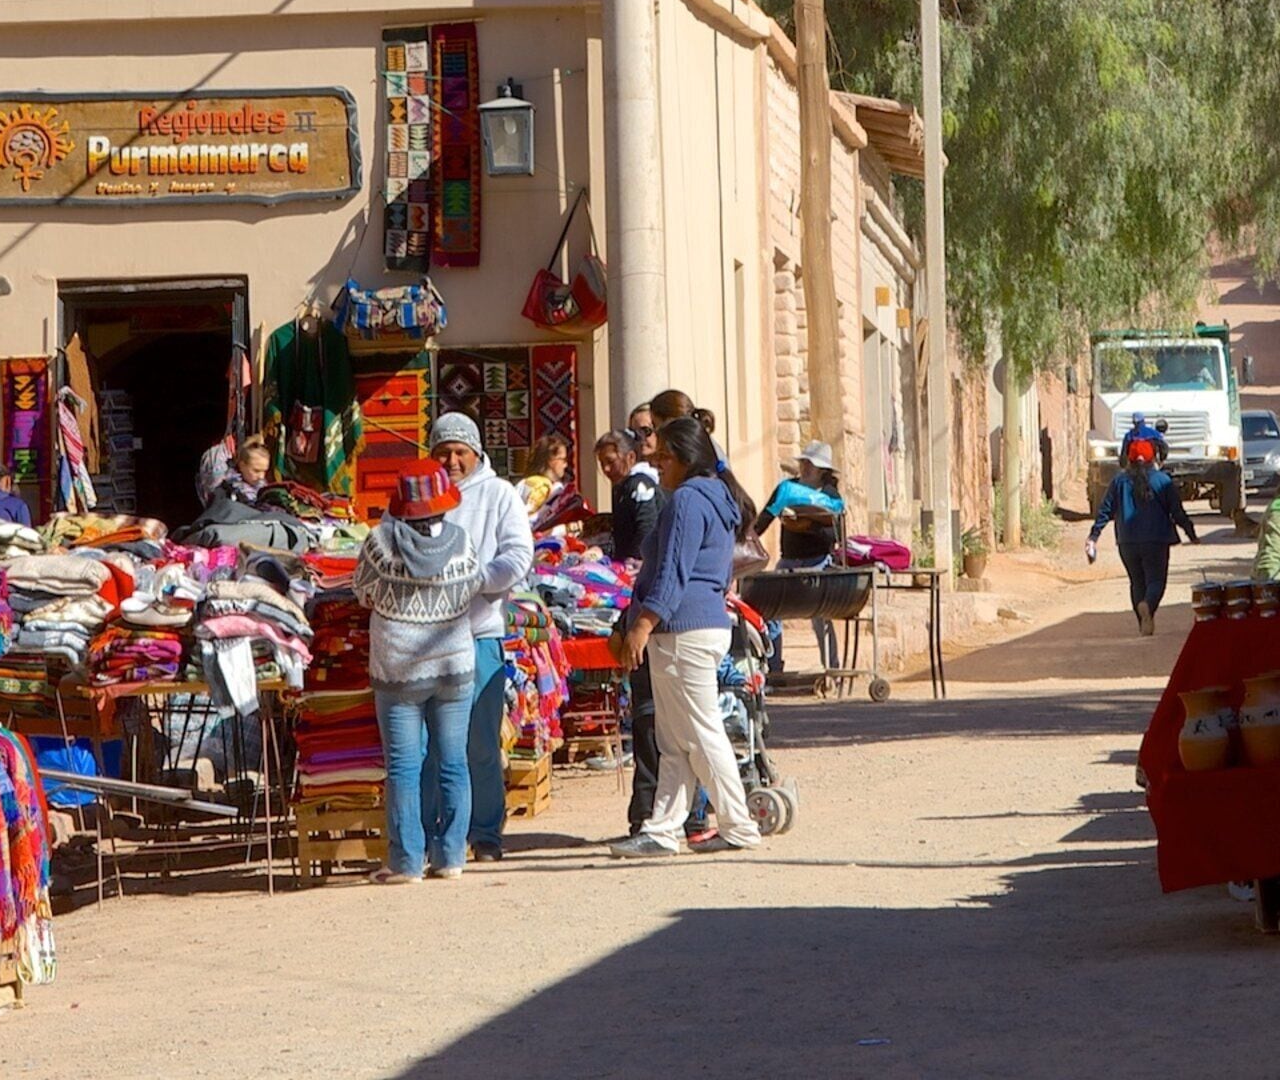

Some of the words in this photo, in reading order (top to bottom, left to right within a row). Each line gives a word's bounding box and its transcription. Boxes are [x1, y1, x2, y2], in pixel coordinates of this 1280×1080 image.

[138, 100, 287, 144] Regionales
[293, 110, 318, 133] II
[87, 135, 309, 176] Purmamarca
